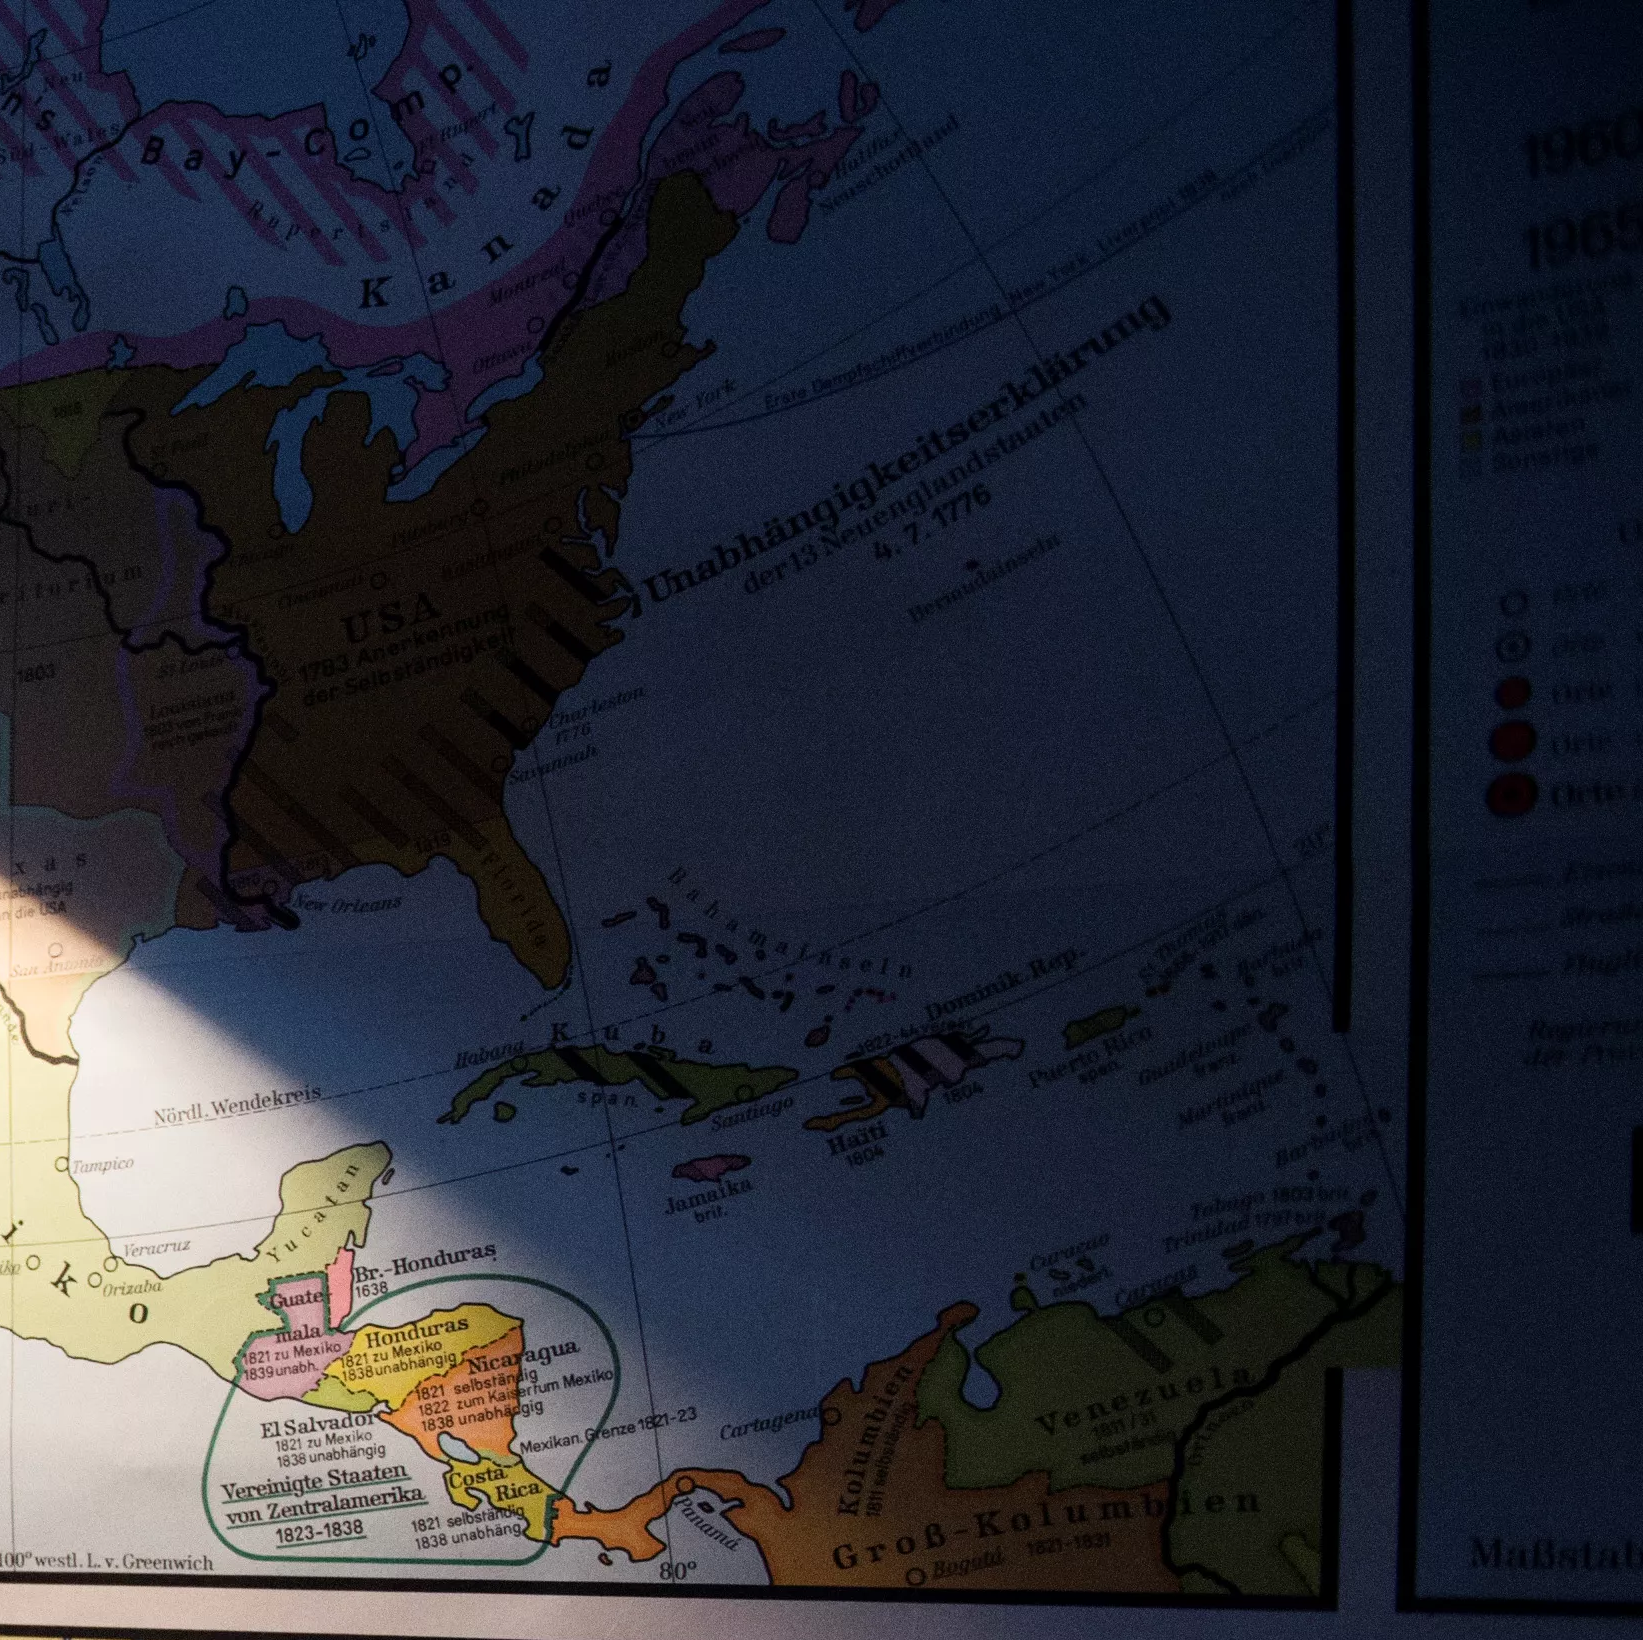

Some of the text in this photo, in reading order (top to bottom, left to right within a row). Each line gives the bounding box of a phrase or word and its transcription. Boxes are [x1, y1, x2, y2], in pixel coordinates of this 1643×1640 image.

[644, 295, 1172, 605] Unabhängigkeitserklärung
[743, 562, 787, 594] der
[820, 394, 1087, 555] Neuenglandstaaten
[341, 593, 441, 643] USA
[356, 603, 510, 667] Anerkennung
[551, 1023, 713, 1053] Kuba
[154, 1084, 322, 1127] Nördl. Wendekreis
[72, 1157, 134, 1175] Tampico
[124, 1239, 191, 1257] Veracruz
[353, 1243, 496, 1283] Br.-Honduras
[103, 1280, 163, 1296] Orizaba
[355, 1281, 388, 1297] 1638
[276, 1325, 321, 1344] mala
[366, 1317, 469, 1348] Honduras
[274, 1351, 289, 1362] zu
[293, 1341, 342, 1358] Mexiko
[341, 1340, 442, 1368] 1821 zu Mexiko
[342, 1352, 456, 1381] 1838 unabhängig
[468, 1339, 580, 1375] Nicaragua
[244, 1364, 273, 1379] 1839
[417, 1369, 537, 1400] 1821 selbständig
[419, 1368, 614, 1416] 1822 zum Kaisertum Mexiko
[1036, 1368, 1255, 1435] Venezuela
[261, 1412, 376, 1439] El Salvador
[421, 1400, 544, 1432] 1838 unabhängig
[520, 1408, 697, 1455] Mexikan. Grenze 1821-23
[720, 1405, 821, 1442] Cartagena
[276, 1430, 373, 1453] 1821 zu Mexiko
[277, 1444, 385, 1468] 1838 unabhängig
[222, 1465, 407, 1500] Vereinigte Staaten
[448, 1468, 543, 1502] Costa Rica
[226, 1487, 424, 1525] von Zentralamerika
[412, 1505, 525, 1533] 1821 selbständig
[276, 1520, 363, 1543] 1823-1838
[415, 1534, 447, 1550] 1838
[834, 1491, 1259, 1568] Groß-Kolumbien
